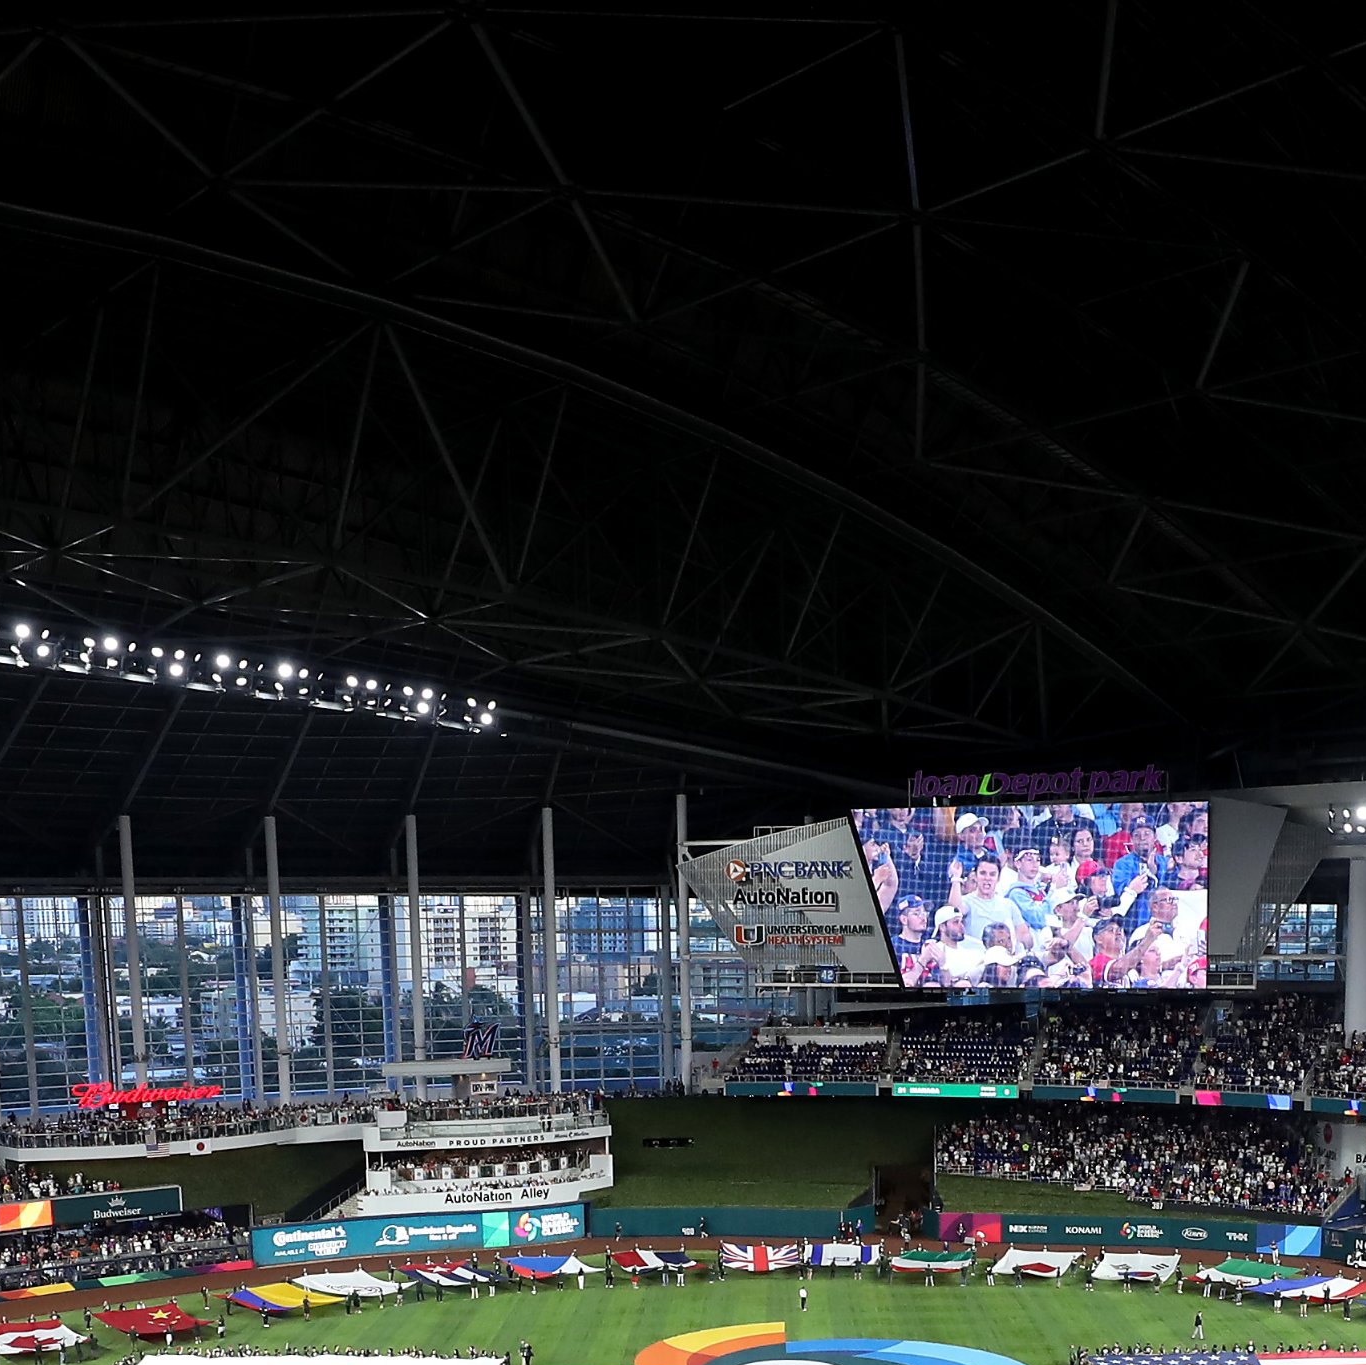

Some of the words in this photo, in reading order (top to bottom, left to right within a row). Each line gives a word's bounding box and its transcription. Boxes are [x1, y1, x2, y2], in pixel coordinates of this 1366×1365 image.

[1087, 764, 1164, 800] park
[734, 887, 836, 905] AutoNation
[767, 925, 823, 935] UNIVERSITY
[825, 925, 836, 934] OF
[838, 925, 874, 934] MIAMI
[767, 935, 803, 945] HEALTH
[803, 936, 844, 945] SYSTEM
[820, 969, 834, 980] 42
[71, 1081, 223, 1109] Budweiser
[396, 1140, 436, 1148] AutoNation
[448, 1138, 486, 1146] PROUD
[492, 1135, 546, 1145] PARTNERS
[444, 1191, 512, 1204] AutoNation
[520, 1188, 550, 1200] Alley
[93, 1206, 142, 1219] Budweiser
[1065, 1226, 1102, 1234] KONAMI
